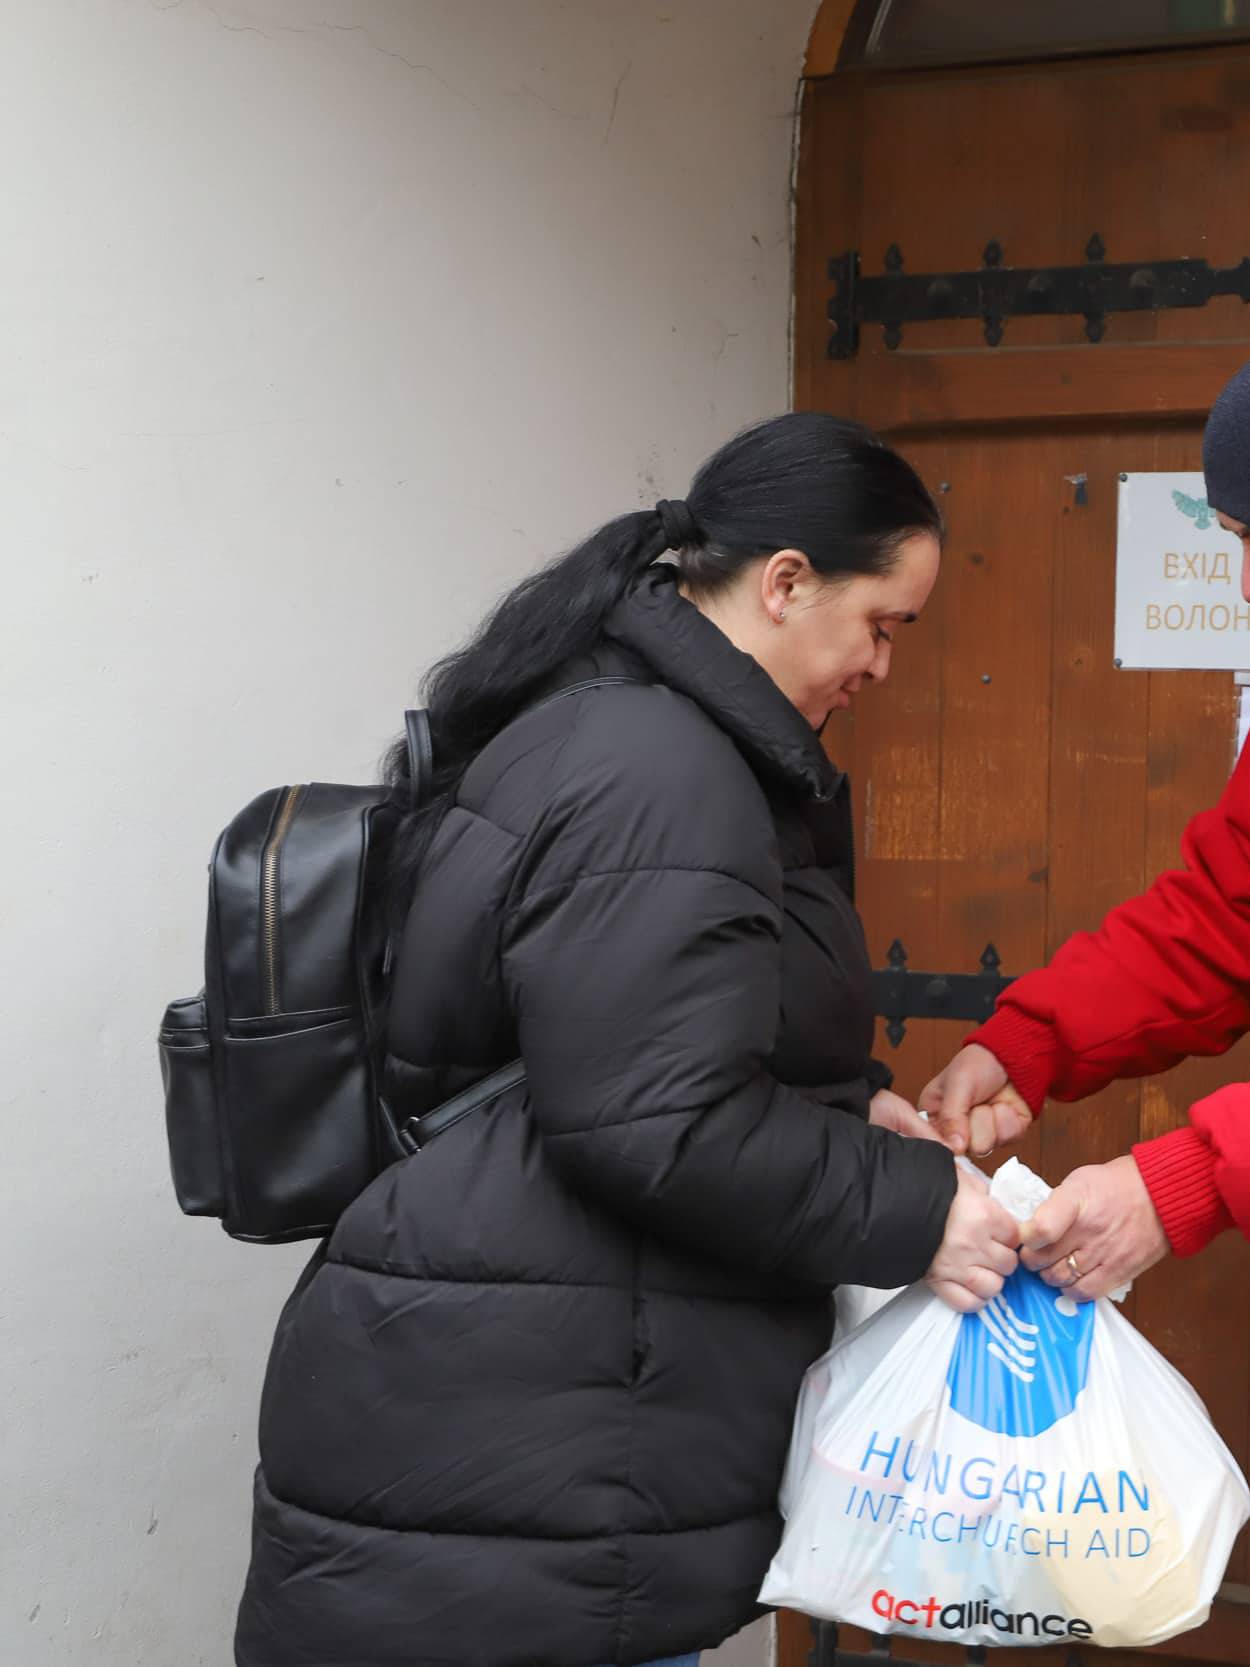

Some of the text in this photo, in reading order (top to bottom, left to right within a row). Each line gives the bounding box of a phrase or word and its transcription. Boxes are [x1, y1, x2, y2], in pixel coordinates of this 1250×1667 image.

[1163, 552, 1232, 584] ВХІД
[859, 1431, 1151, 1514] HUNGARIAN
[1084, 1527, 1151, 1559] AID
[871, 1588, 1094, 1640] actalliance
